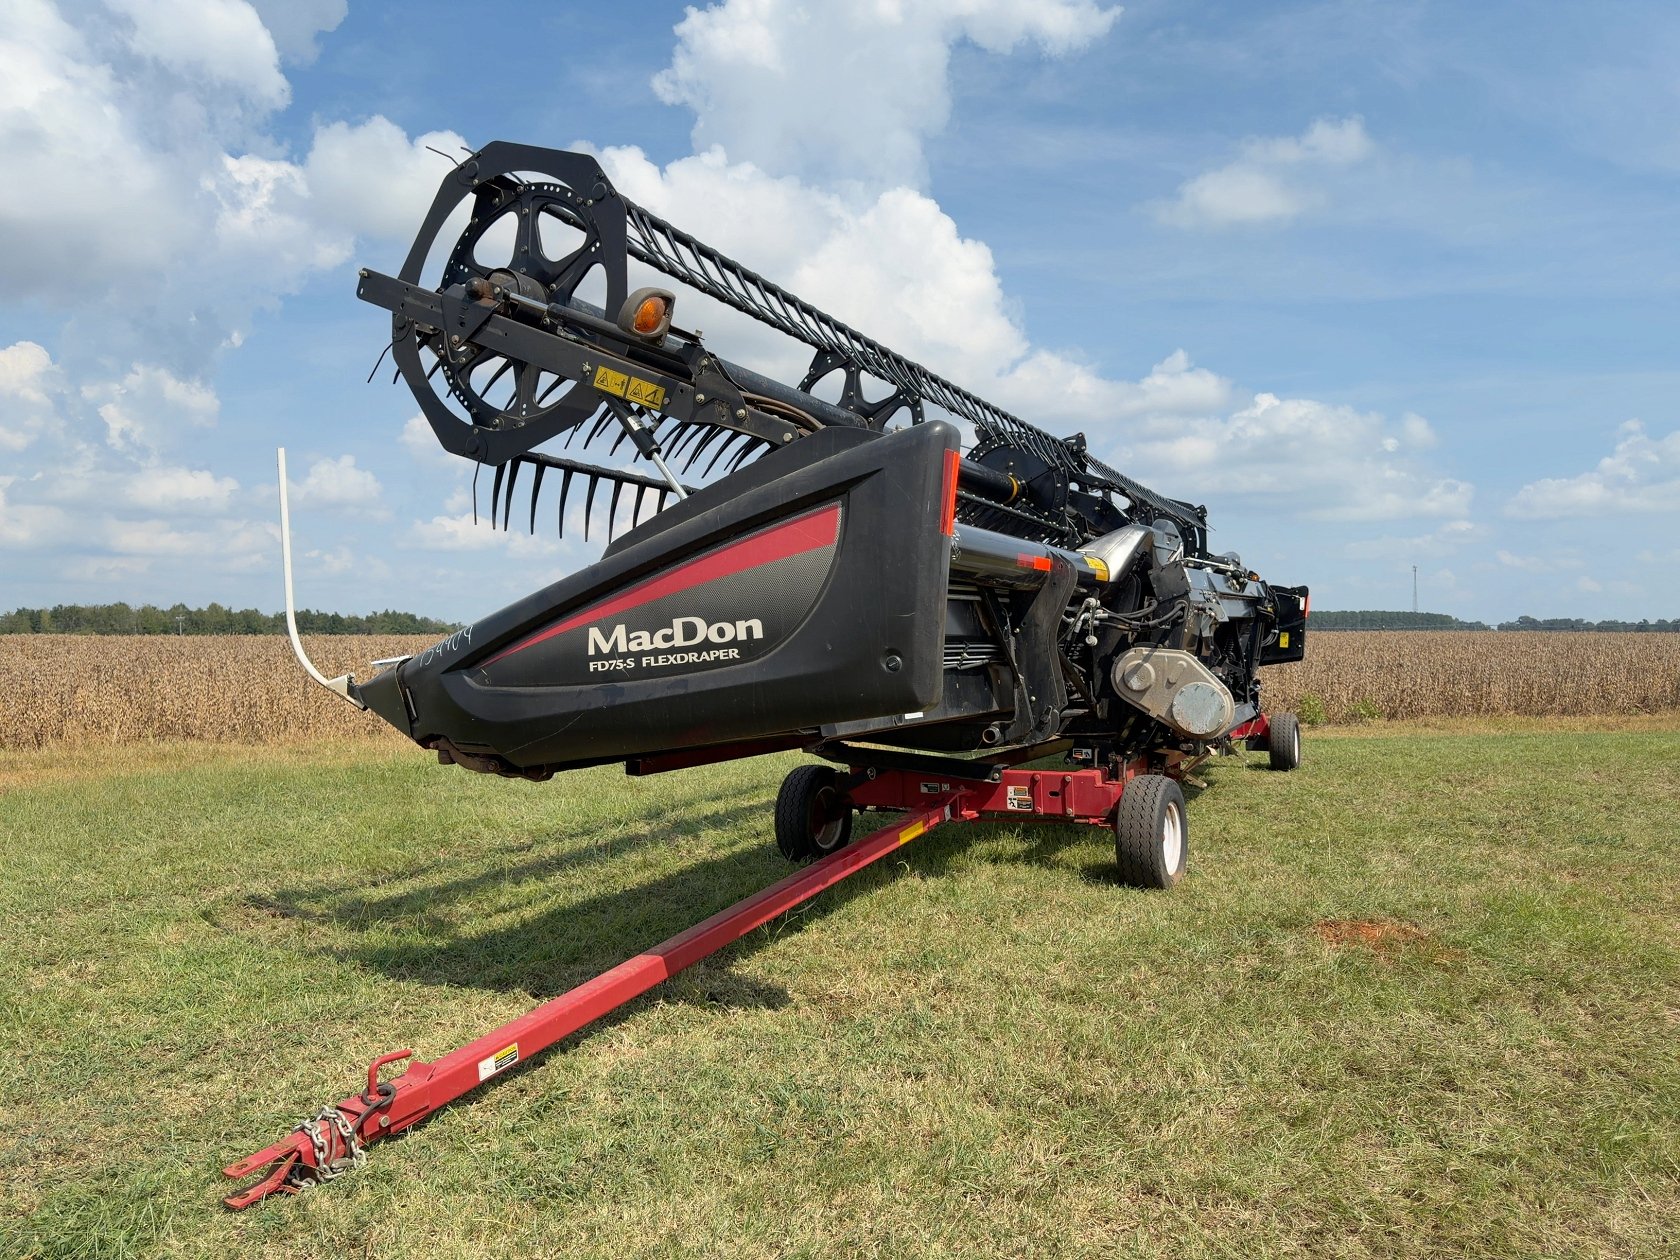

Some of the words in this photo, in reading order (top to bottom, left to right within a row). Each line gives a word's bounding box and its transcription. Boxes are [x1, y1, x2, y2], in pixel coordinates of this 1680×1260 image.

[587, 616, 764, 656] MacDon
[589, 658, 635, 672] FD75-S
[642, 648, 740, 667] FLEXDRAPER
